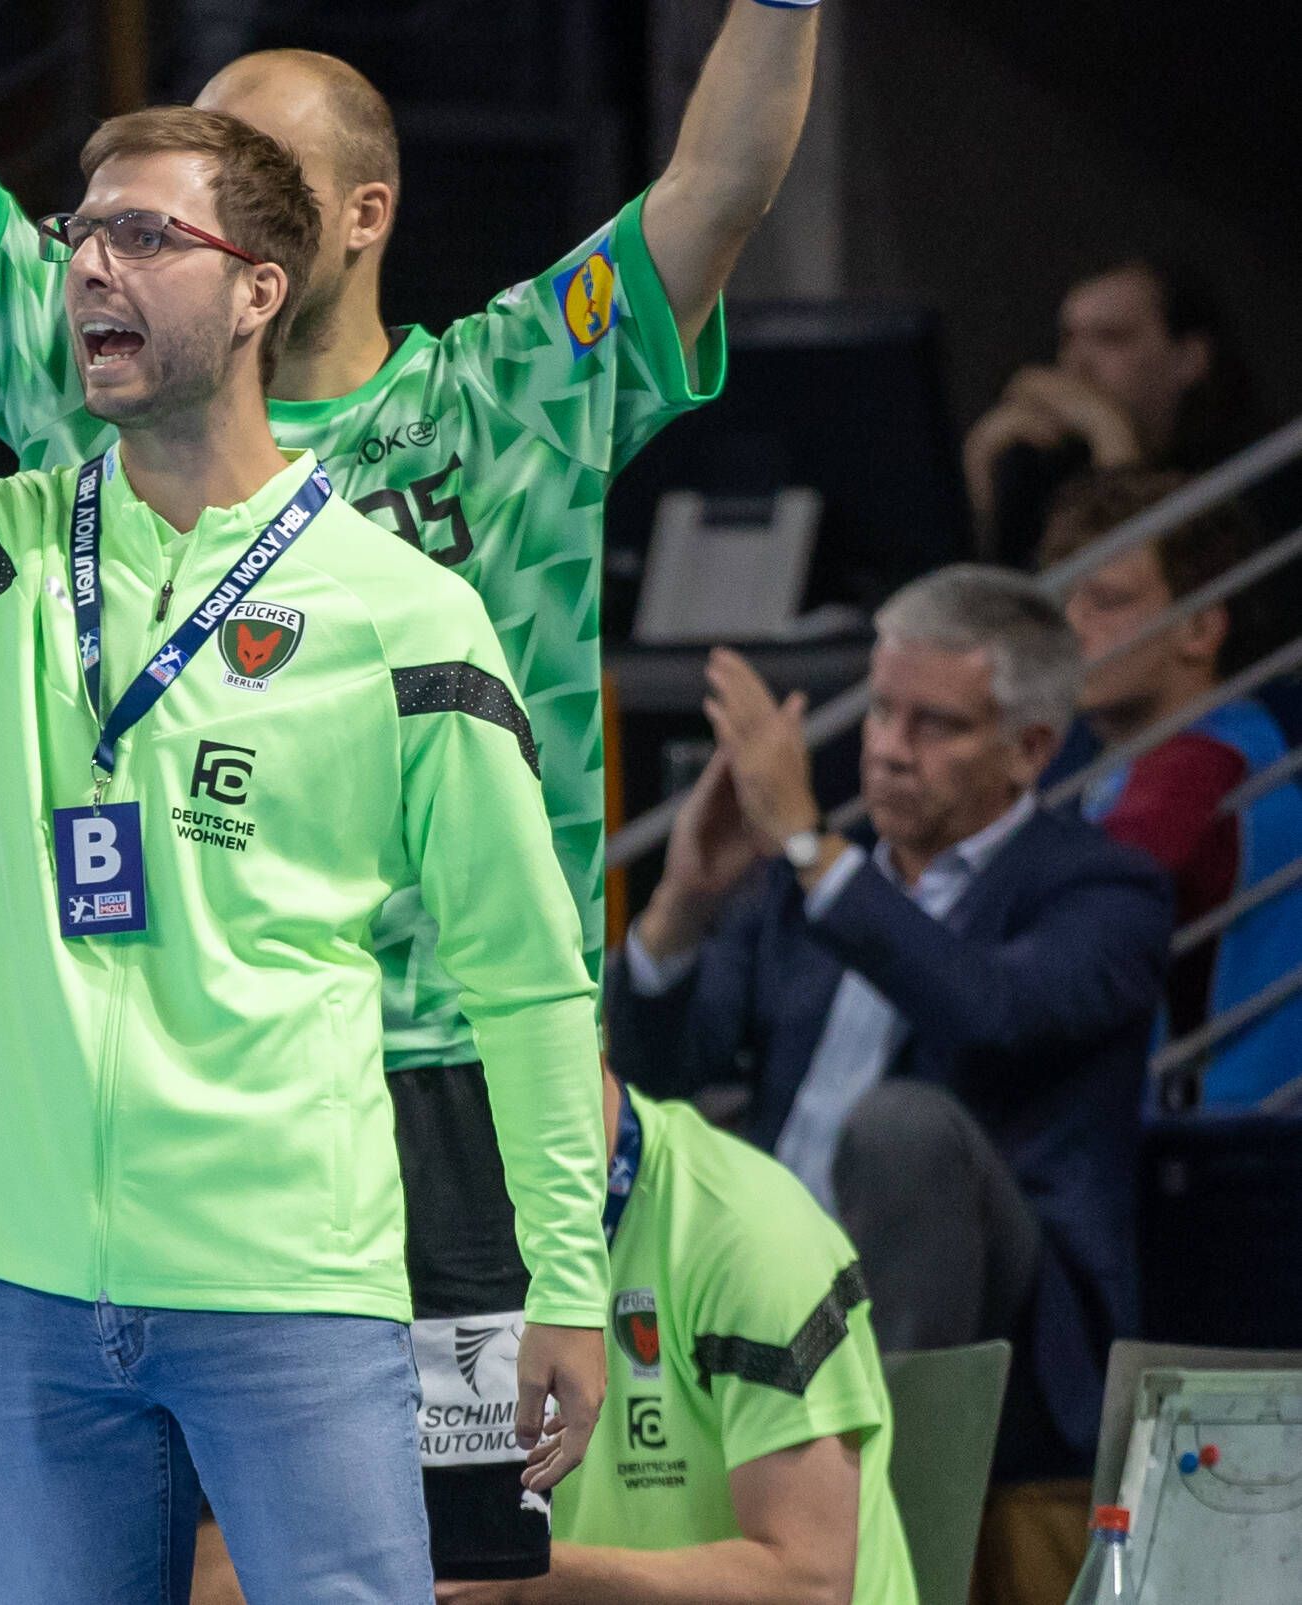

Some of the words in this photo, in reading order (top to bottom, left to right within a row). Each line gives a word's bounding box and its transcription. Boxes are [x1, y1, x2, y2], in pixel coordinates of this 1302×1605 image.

[358, 427, 406, 465] OK
[78, 469, 98, 503] HBL
[75, 507, 96, 553] MOLY
[75, 555, 95, 606] LIQUI
[192, 582, 241, 631] LIQUI
[232, 532, 282, 586] MOLY
[274, 504, 311, 539] HBL
[234, 603, 297, 627] FÜCHSE
[226, 674, 265, 690] BERLIN
[171, 807, 256, 837] DEUTSCHE
[72, 817, 122, 885] B
[176, 824, 248, 852] WOHNEN
[99, 895, 126, 905] LIQUI
[99, 903, 128, 915] MOLY
[424, 1401, 519, 1429] SCHIM
[419, 1429, 518, 1455] AUTOMO
